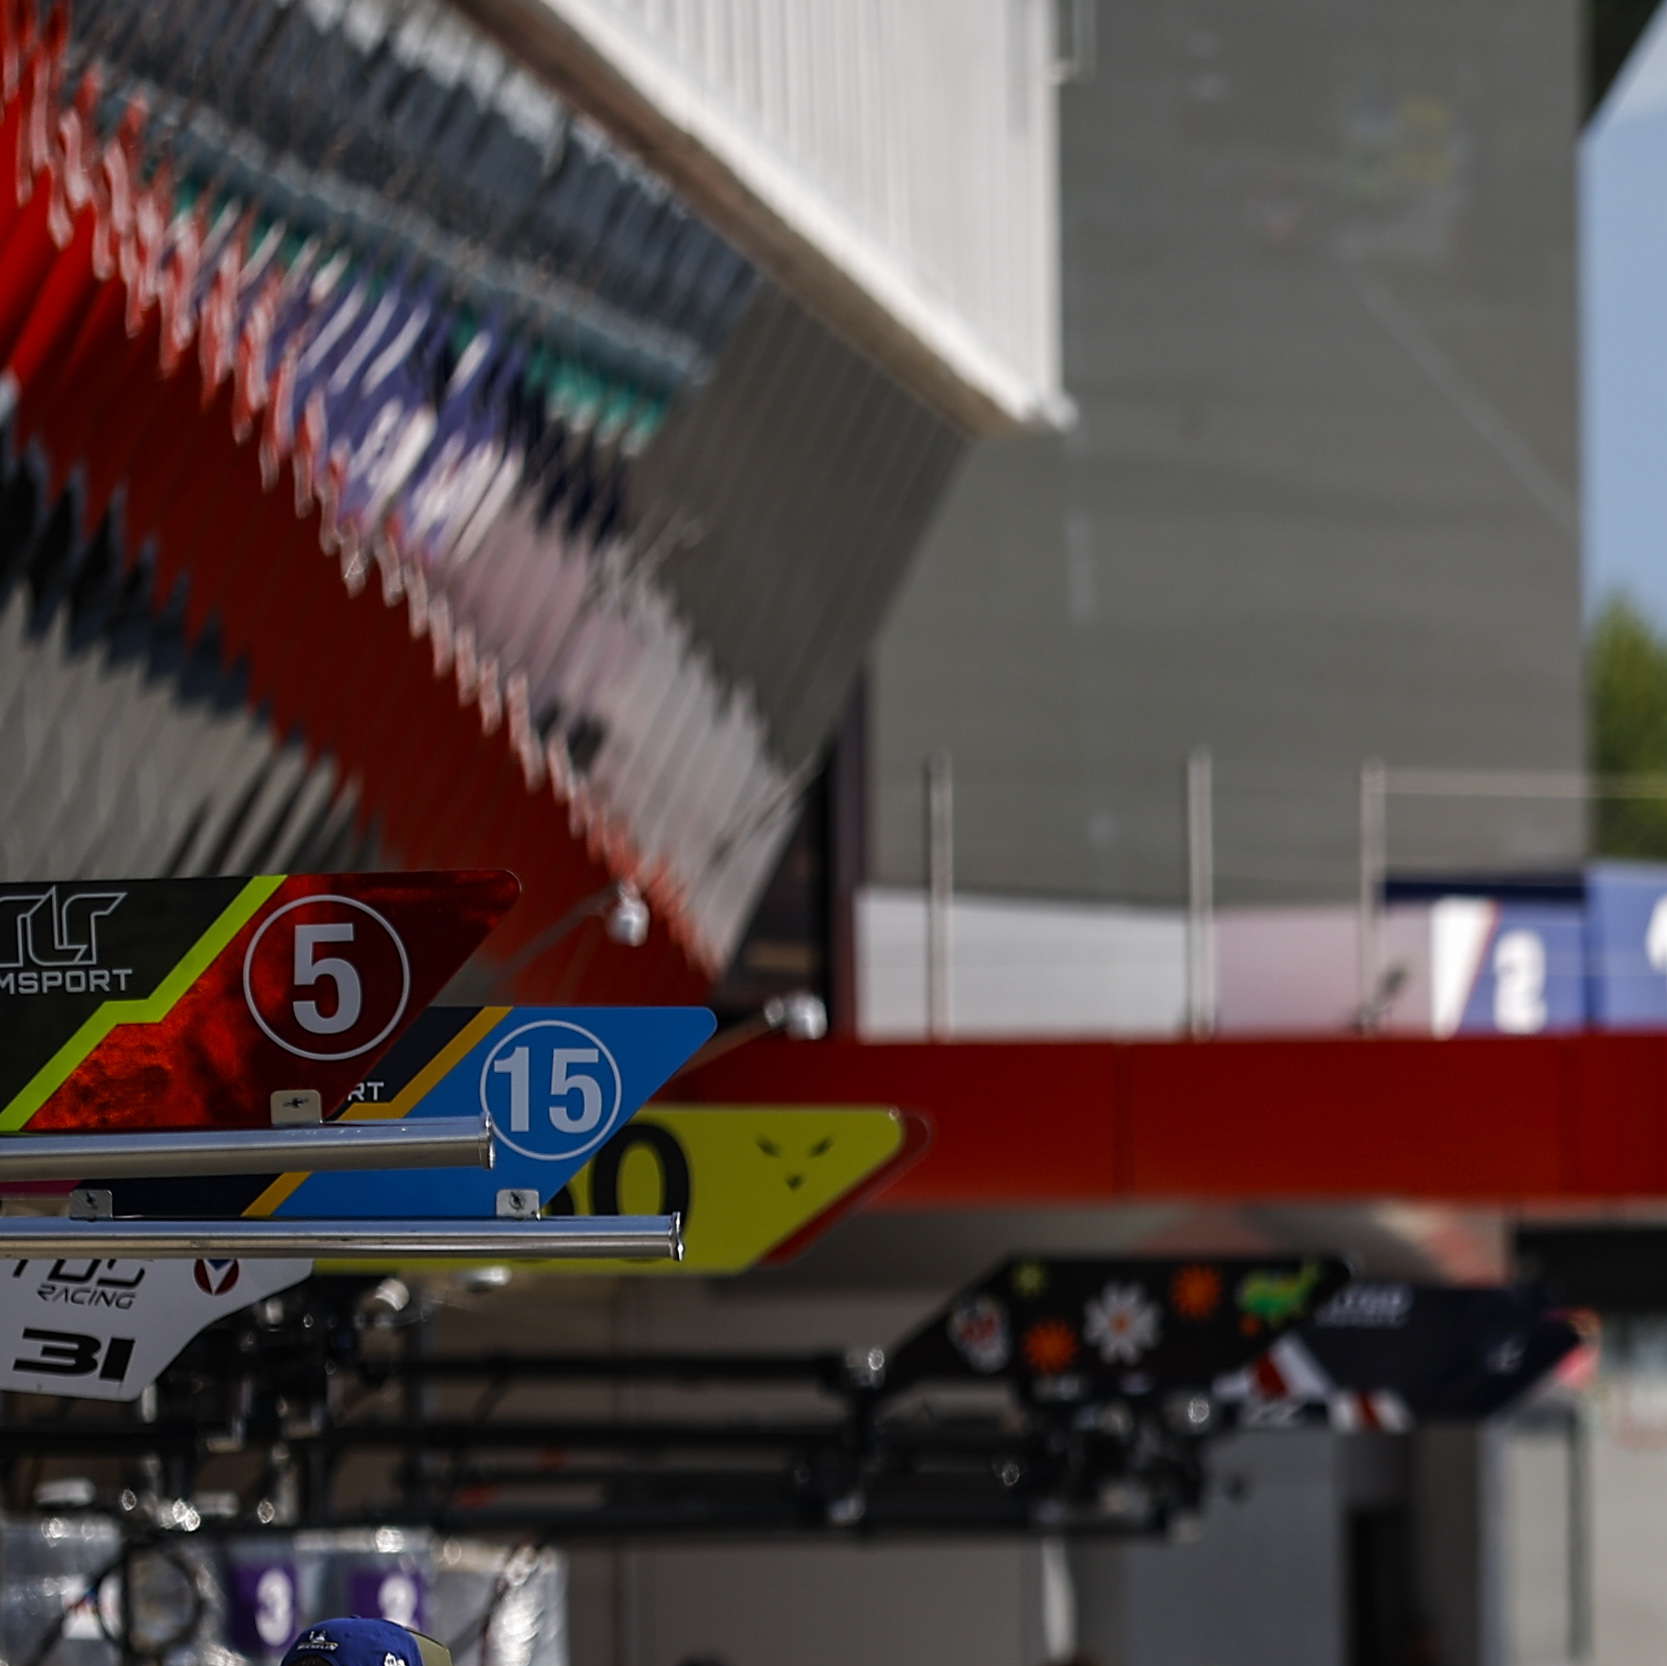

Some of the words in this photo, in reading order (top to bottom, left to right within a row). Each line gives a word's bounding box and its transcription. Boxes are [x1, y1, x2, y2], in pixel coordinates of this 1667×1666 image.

[291, 922, 363, 1034] 5
[493, 1046, 603, 1134] 15
[37, 1284, 136, 1310] RACING
[12, 1327, 136, 1383] 31
